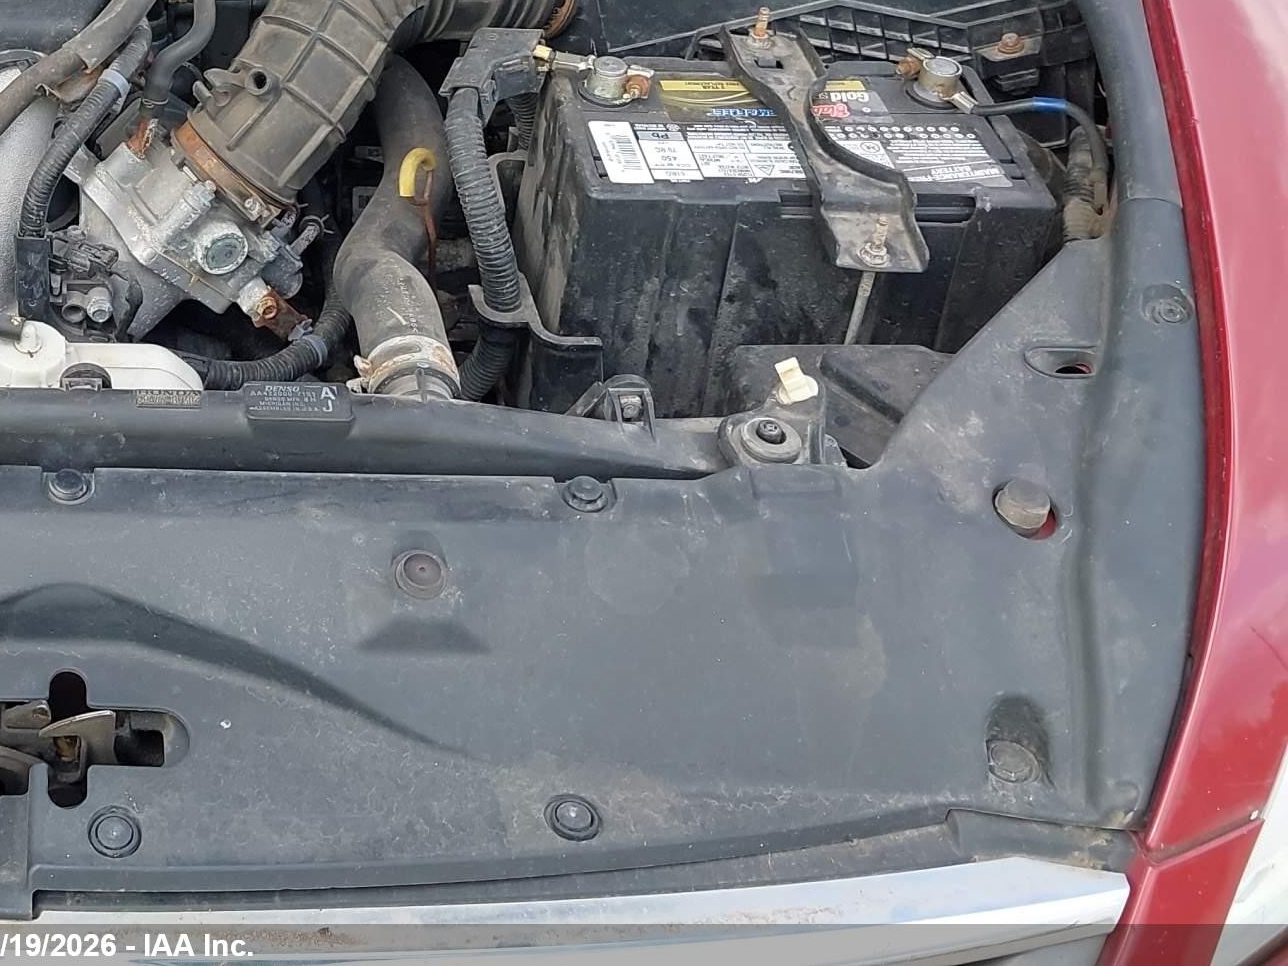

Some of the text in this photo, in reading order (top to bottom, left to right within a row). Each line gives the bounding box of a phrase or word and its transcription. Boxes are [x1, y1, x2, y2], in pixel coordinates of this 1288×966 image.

[829, 92, 870, 102] Gold
[651, 132, 669, 140] Pb
[930, 165, 972, 175] BATTERY
[264, 385, 300, 393] DENSO
[319, 386, 337, 400] A
[322, 399, 334, 412] J
